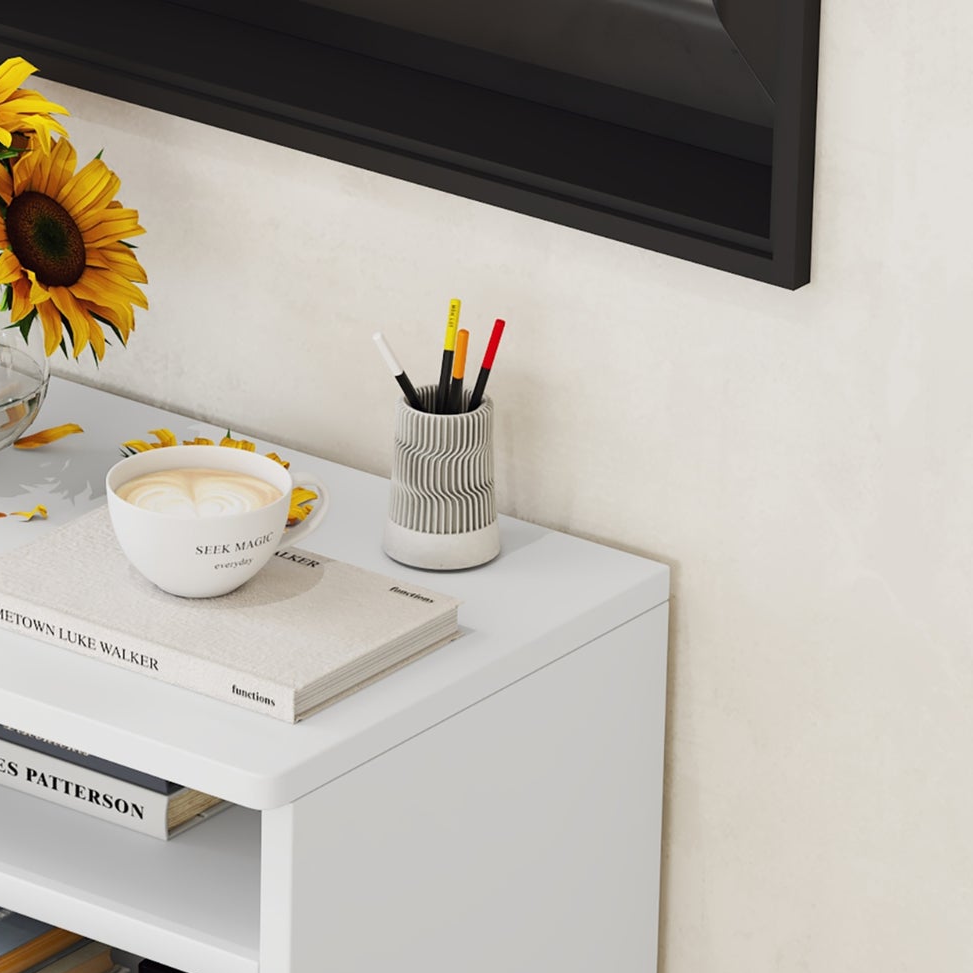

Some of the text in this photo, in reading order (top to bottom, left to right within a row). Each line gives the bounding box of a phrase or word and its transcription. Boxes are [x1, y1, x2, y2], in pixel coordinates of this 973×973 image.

[195, 531, 274, 555] SEEK MAGIC
[214, 557, 253, 570] everyday
[389, 586, 434, 604] functions
[58, 627, 97, 651] LUKE
[99, 640, 160, 672] WALKER
[231, 683, 276, 707] functions
[26, 766, 145, 820] PATTERSON
